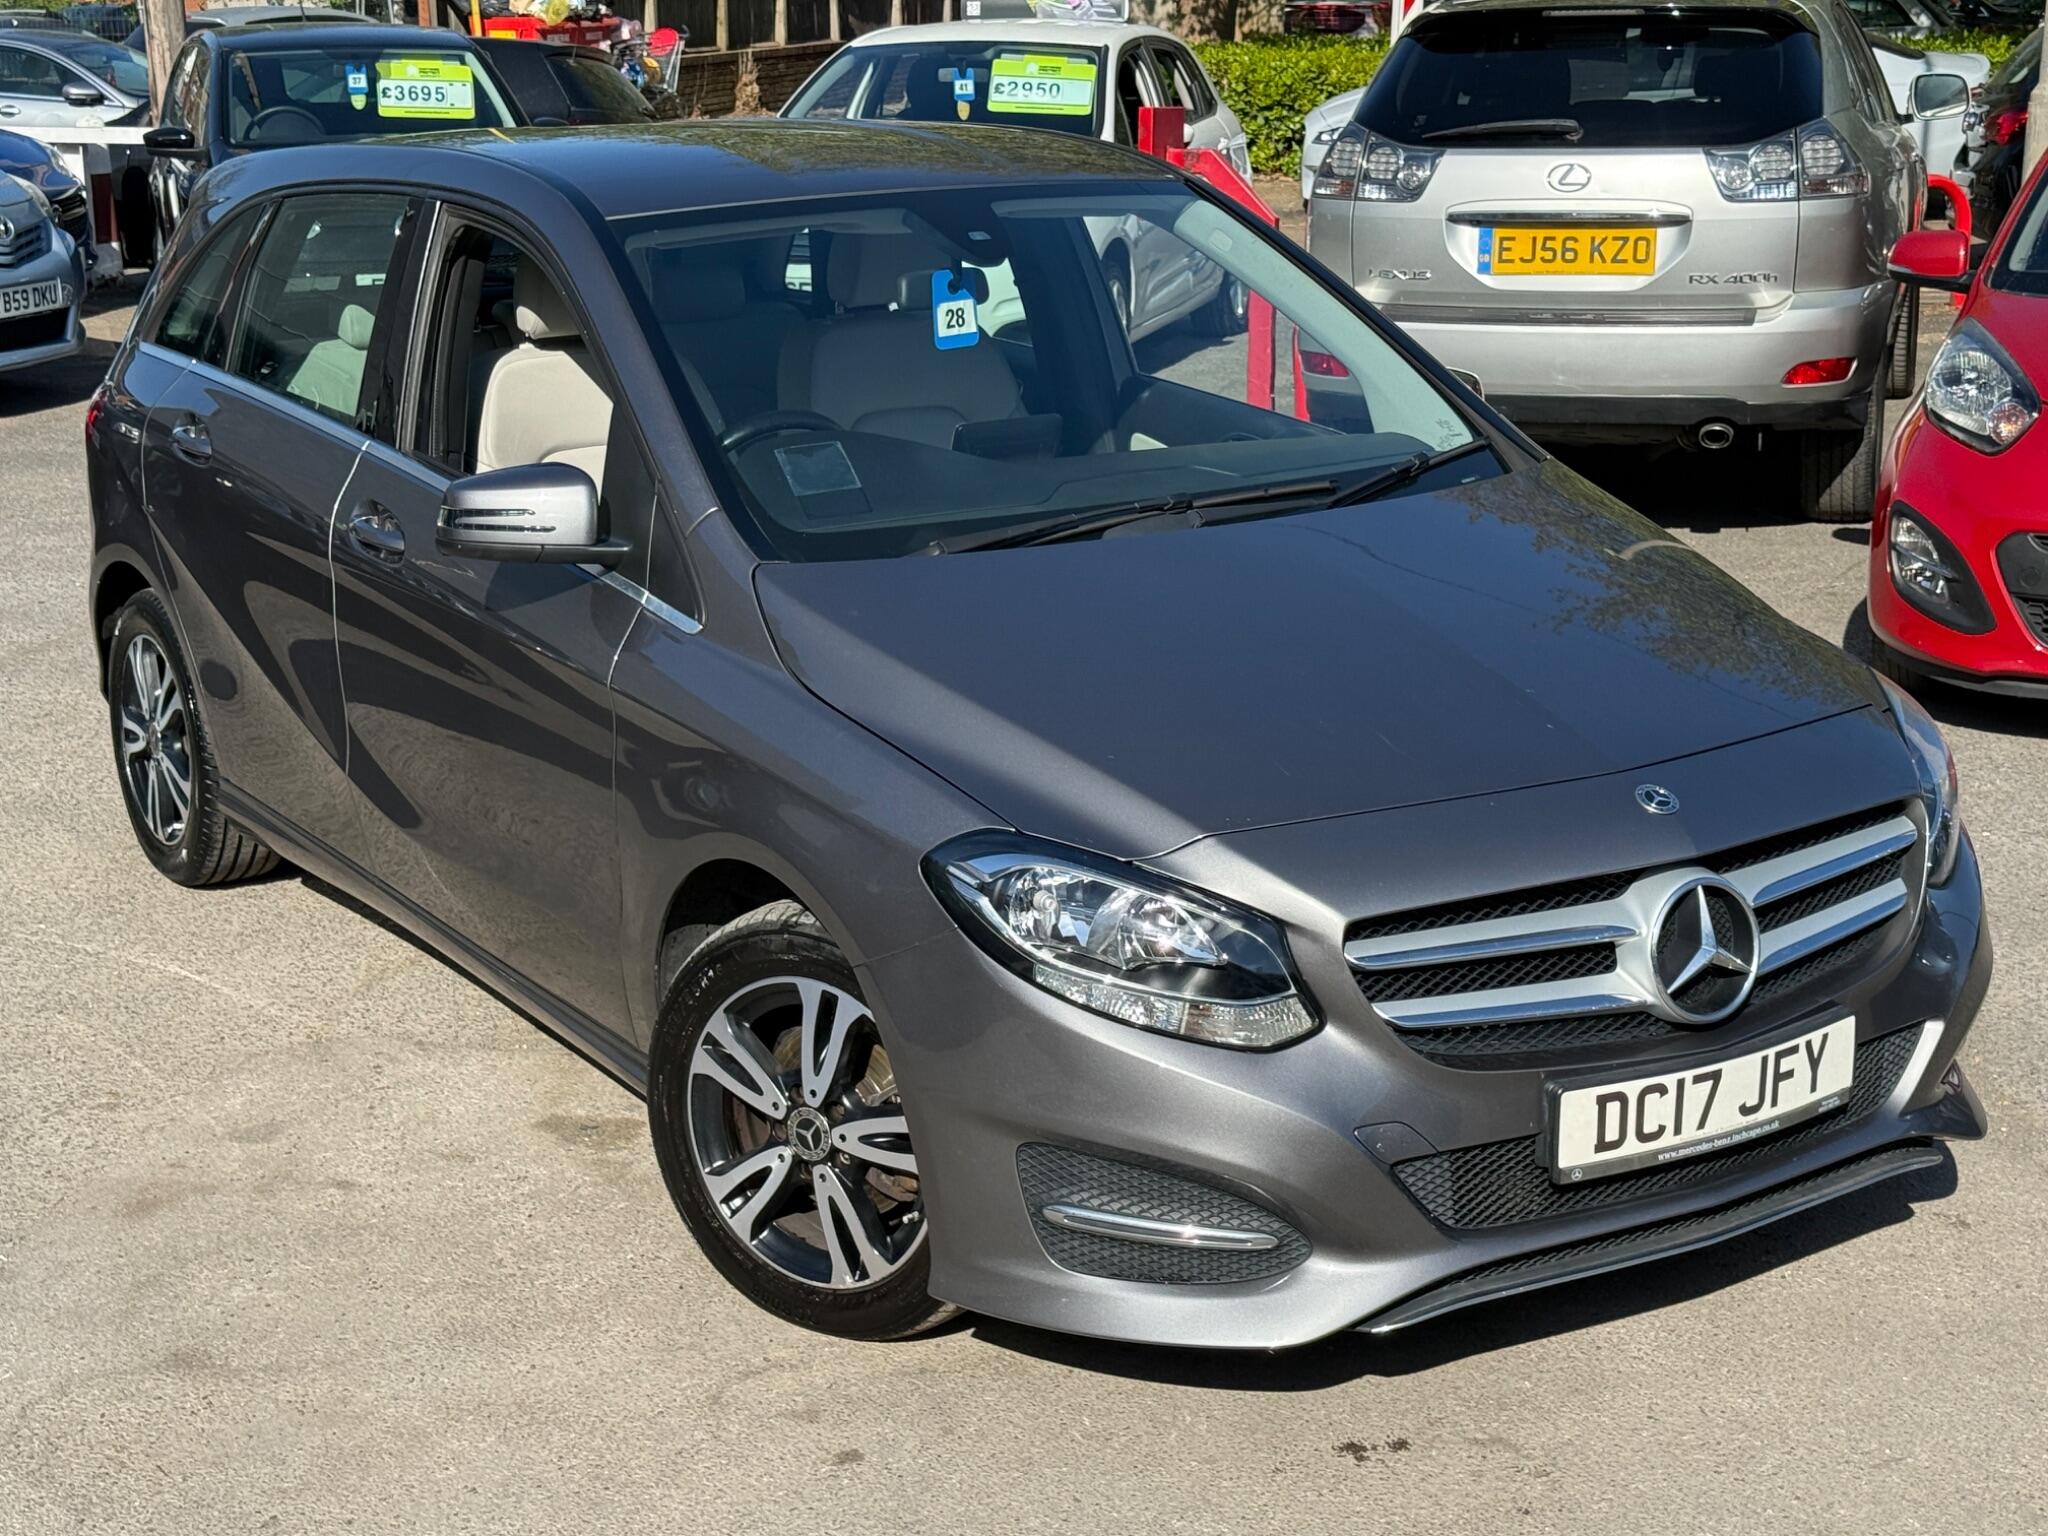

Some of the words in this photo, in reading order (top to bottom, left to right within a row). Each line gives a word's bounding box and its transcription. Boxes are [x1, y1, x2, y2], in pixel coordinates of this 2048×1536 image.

[381, 85, 447, 103] £3695
[993, 80, 1061, 99] £2950
[1497, 236, 1580, 265] EJ56
[1588, 236, 1651, 265] KZO
[1688, 273, 1719, 285] RX
[0, 289, 30, 314] B59
[32, 283, 58, 308] DKU
[944, 307, 966, 330] 28
[1594, 1068, 1723, 1155] DC17
[1738, 1032, 1829, 1118] JFY
